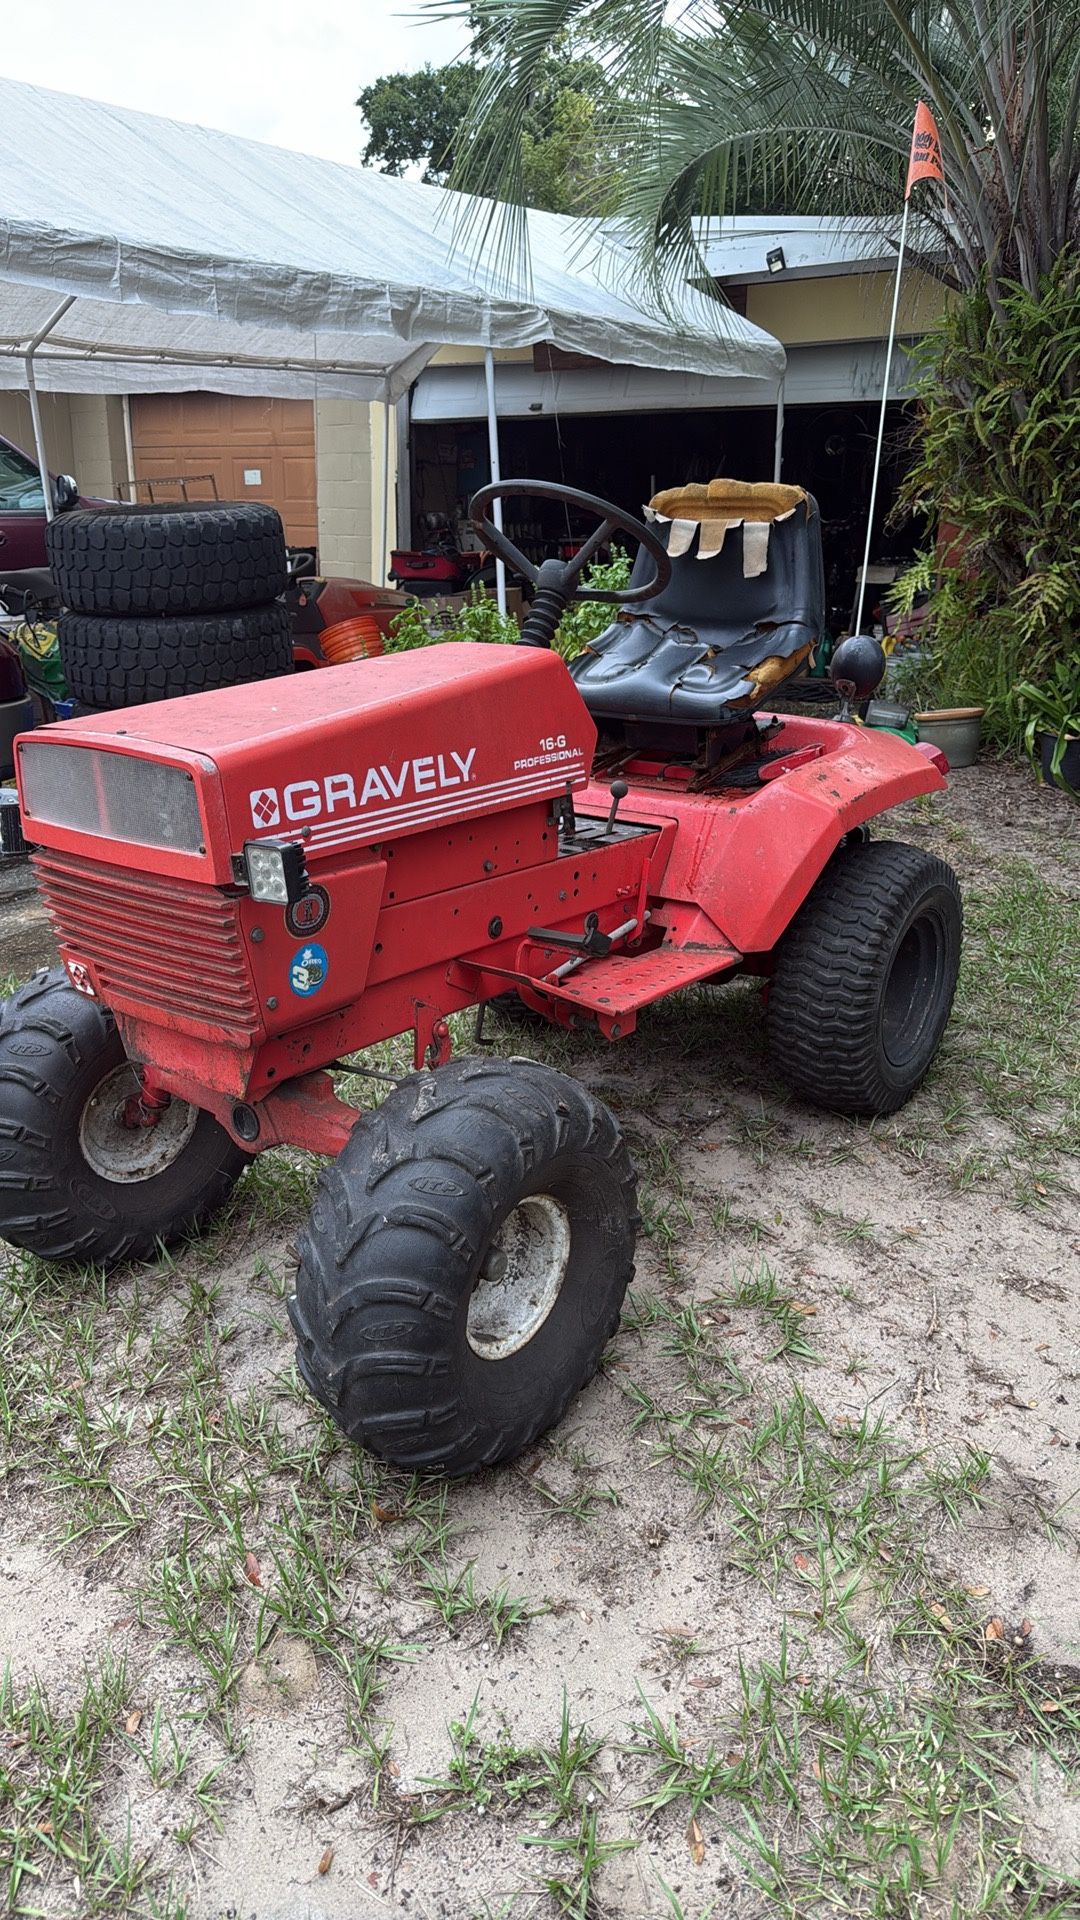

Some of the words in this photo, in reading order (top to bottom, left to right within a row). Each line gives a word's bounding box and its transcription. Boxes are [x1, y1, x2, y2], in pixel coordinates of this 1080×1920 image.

[513, 747, 584, 770] PROFESSIONAL
[283, 747, 477, 821] GRAVELY
[292, 965, 309, 991] 3
